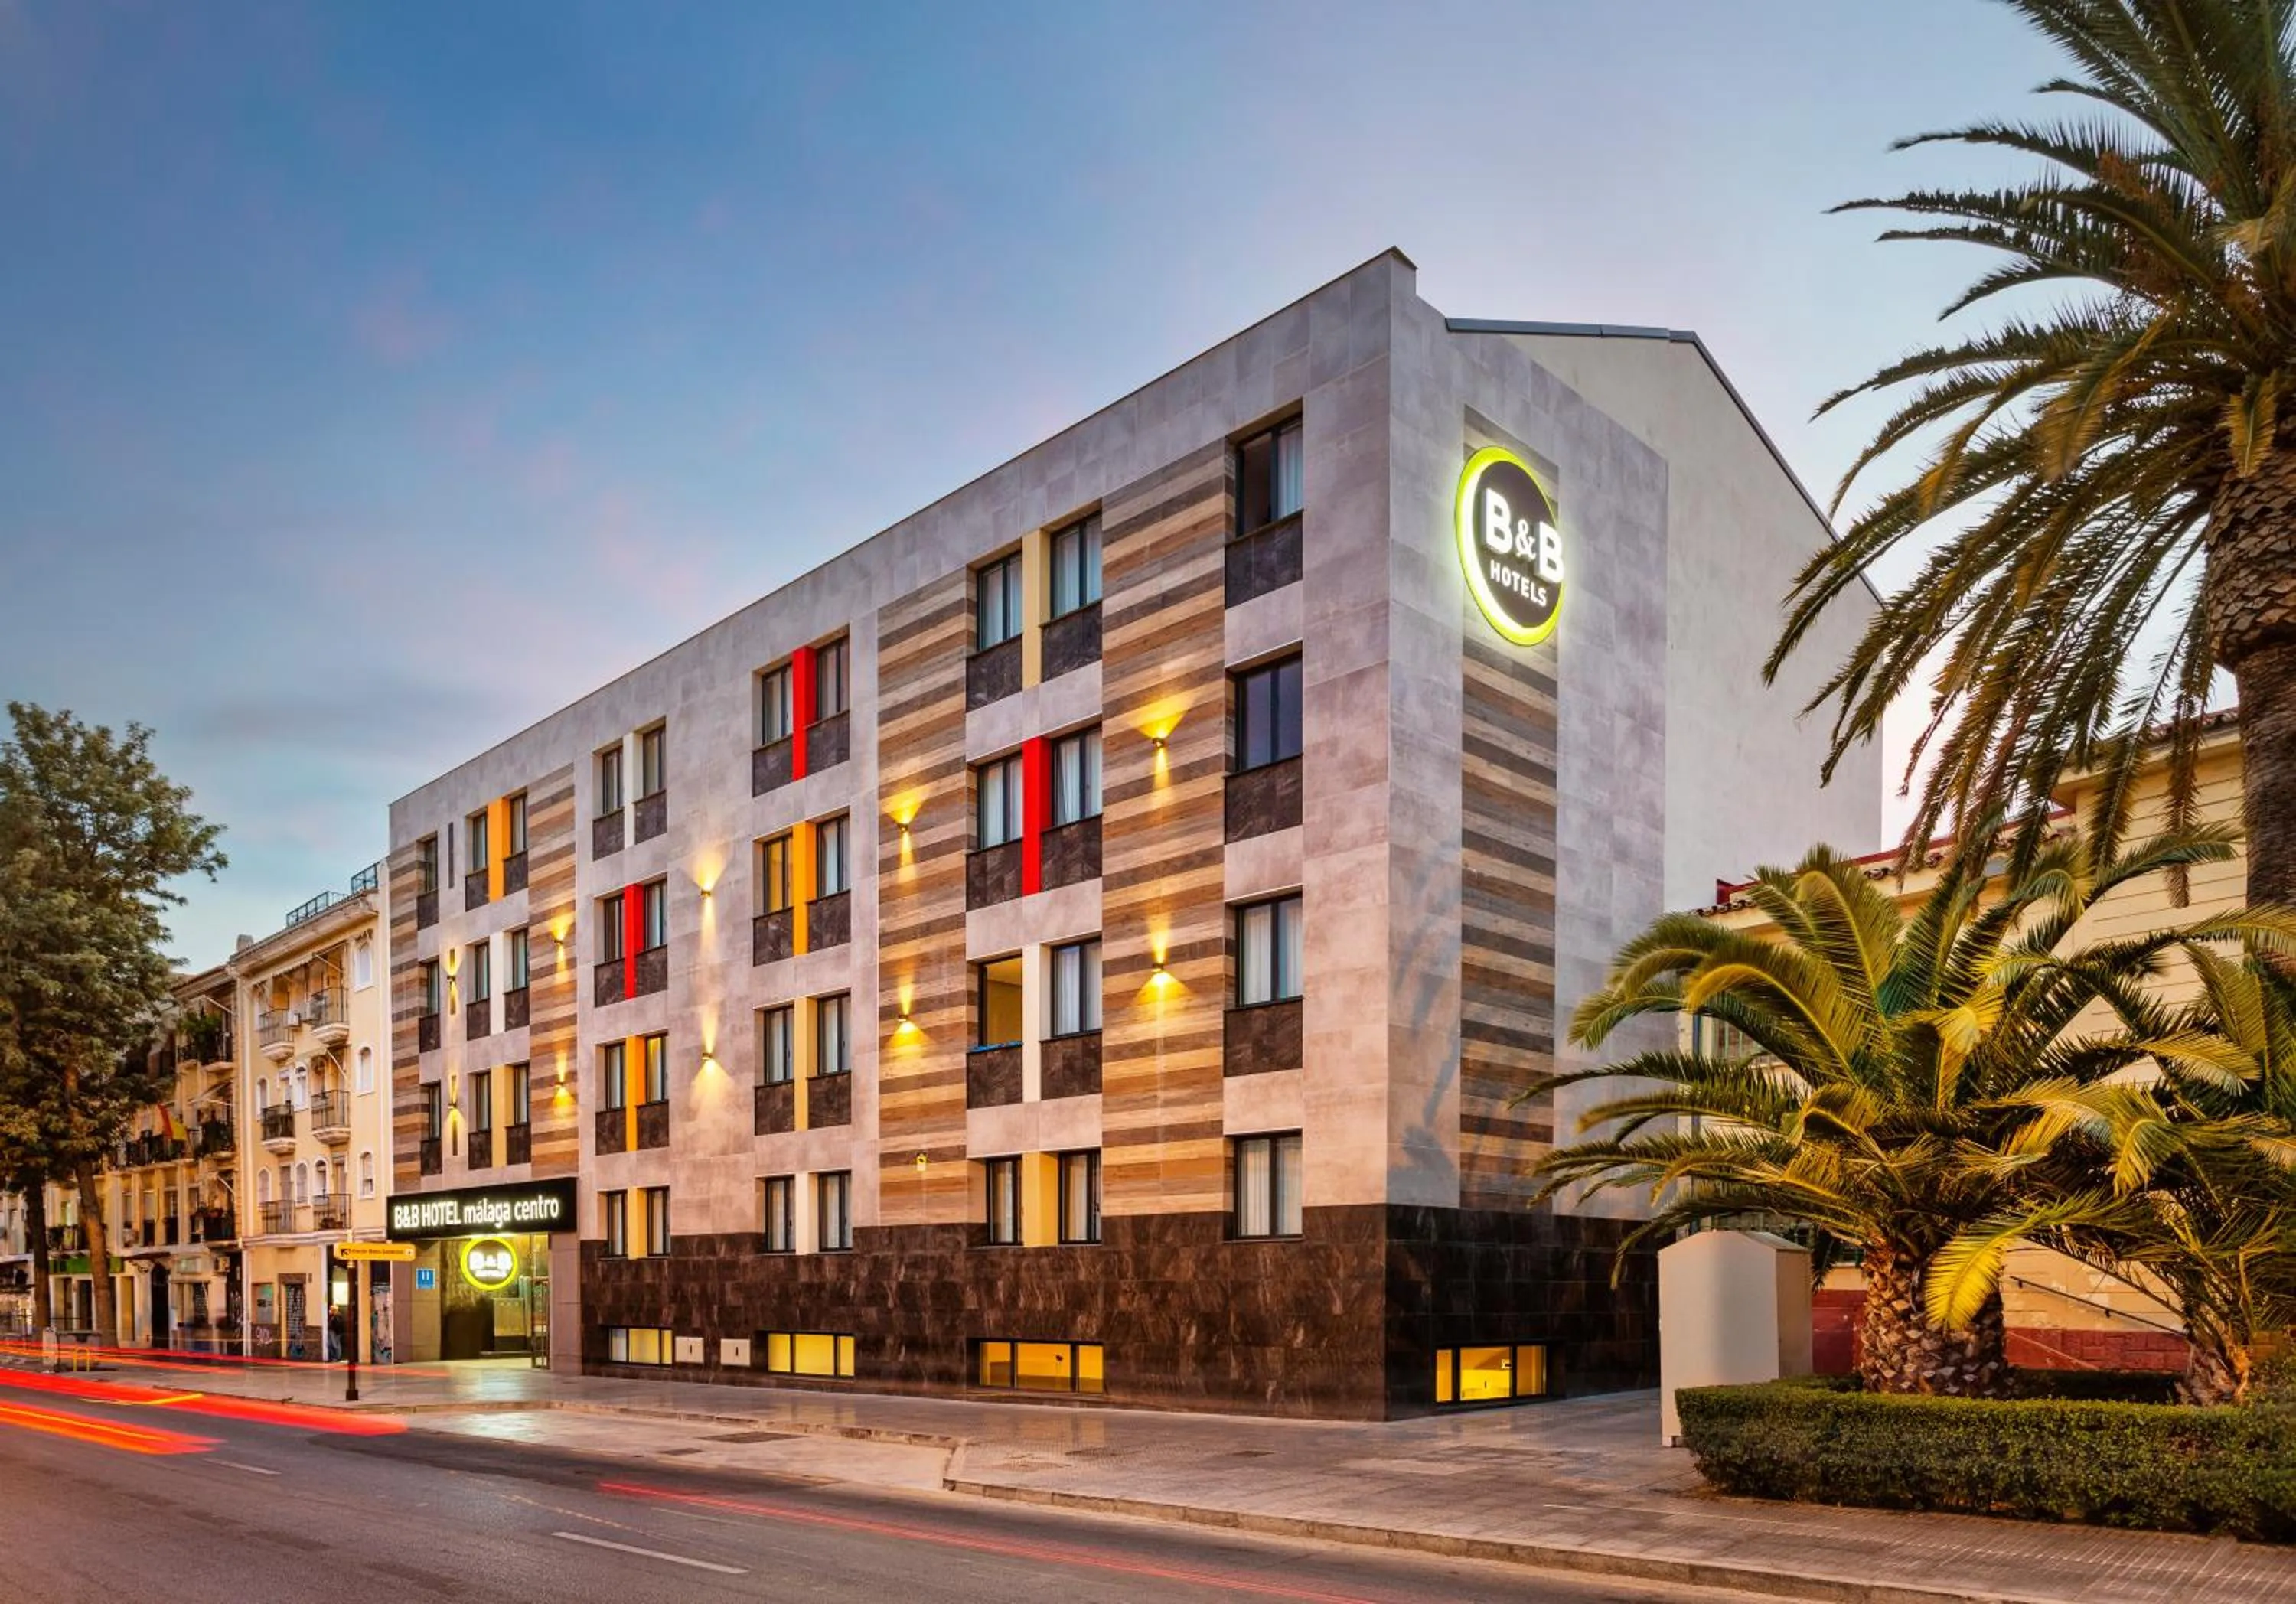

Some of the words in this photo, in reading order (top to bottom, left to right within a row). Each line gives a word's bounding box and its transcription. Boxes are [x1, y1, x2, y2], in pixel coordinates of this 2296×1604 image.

[1486, 488, 1564, 583] B&B
[1490, 559, 1547, 607] HOTELS
[394, 1204, 419, 1228] B&B
[422, 1201, 461, 1226] HOTEL
[463, 1198, 510, 1227] málaga
[514, 1195, 559, 1220] centro
